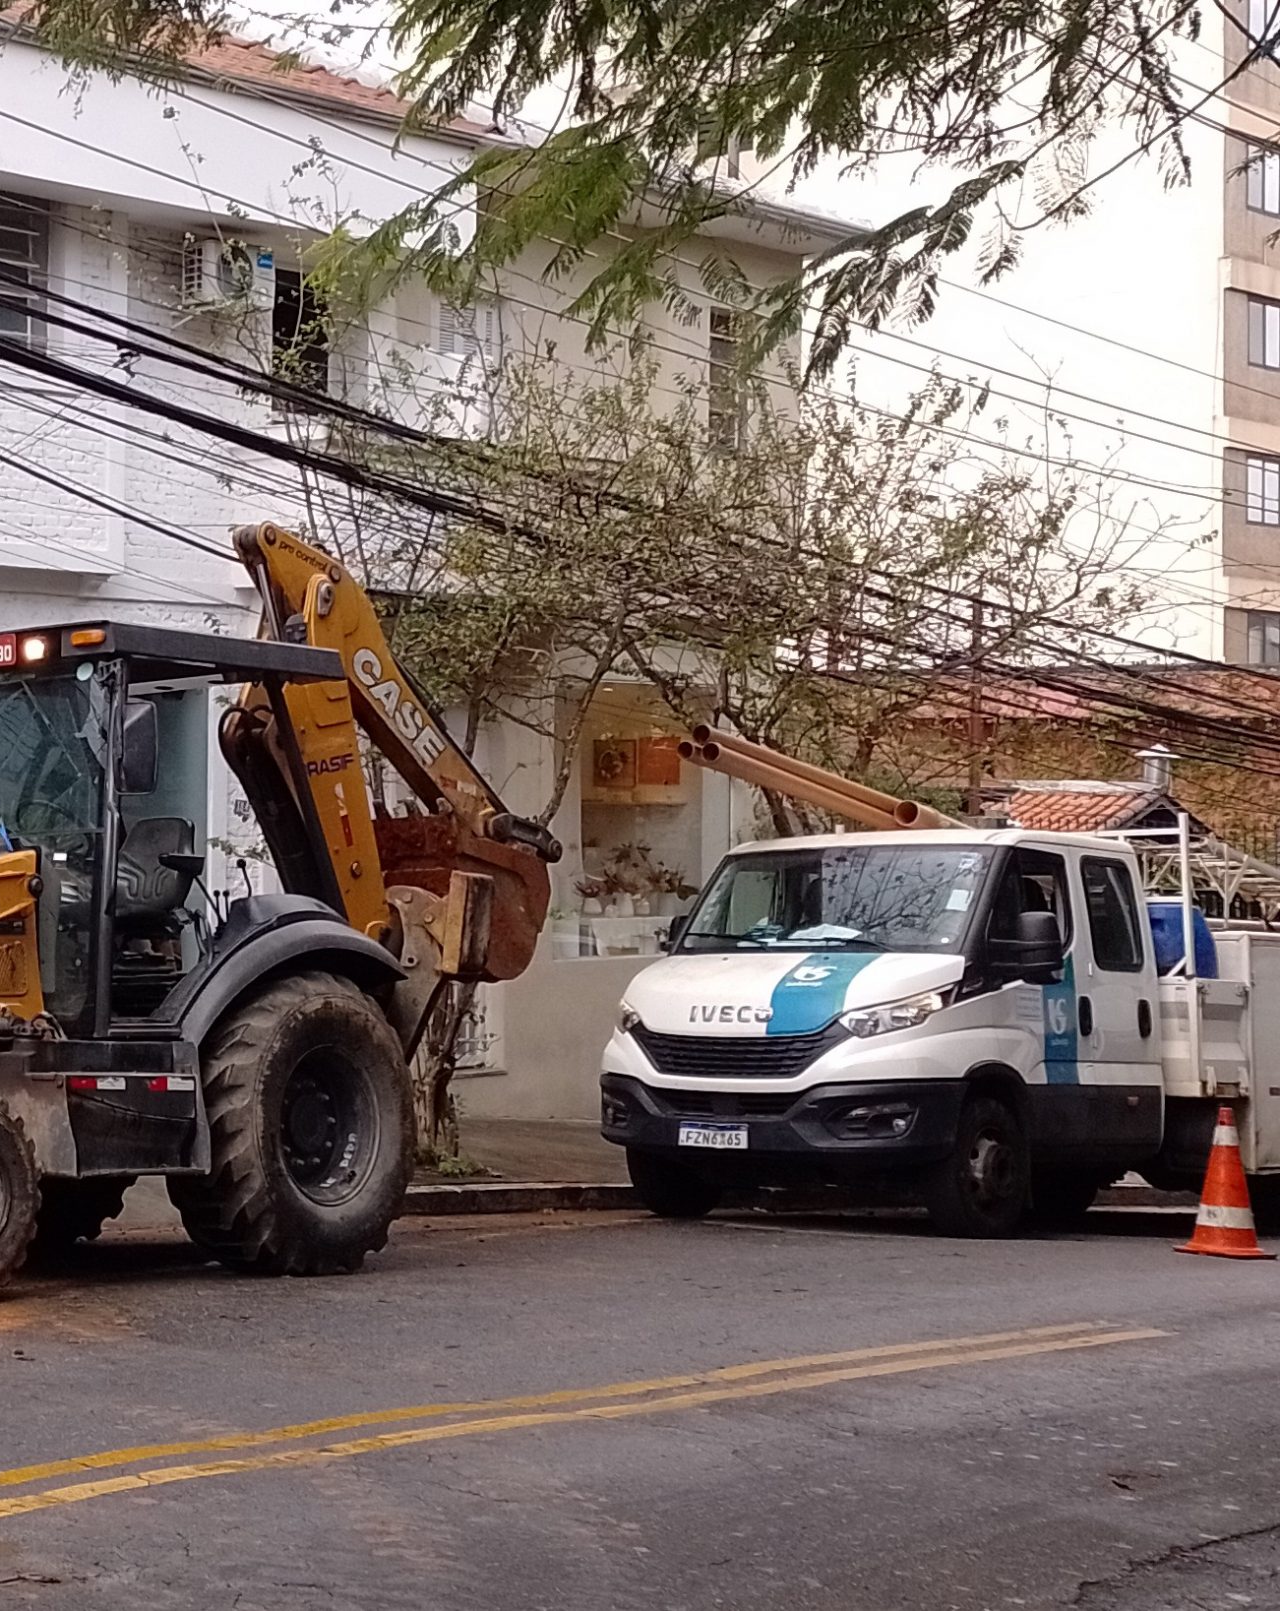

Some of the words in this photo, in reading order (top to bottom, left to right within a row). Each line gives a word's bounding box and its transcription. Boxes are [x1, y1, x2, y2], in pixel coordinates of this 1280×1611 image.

[279, 540, 295, 554] pro
[296, 550, 327, 572] control
[353, 647, 446, 768] CASE
[306, 753, 355, 777] RASIF
[689, 1005, 773, 1024] IVECO
